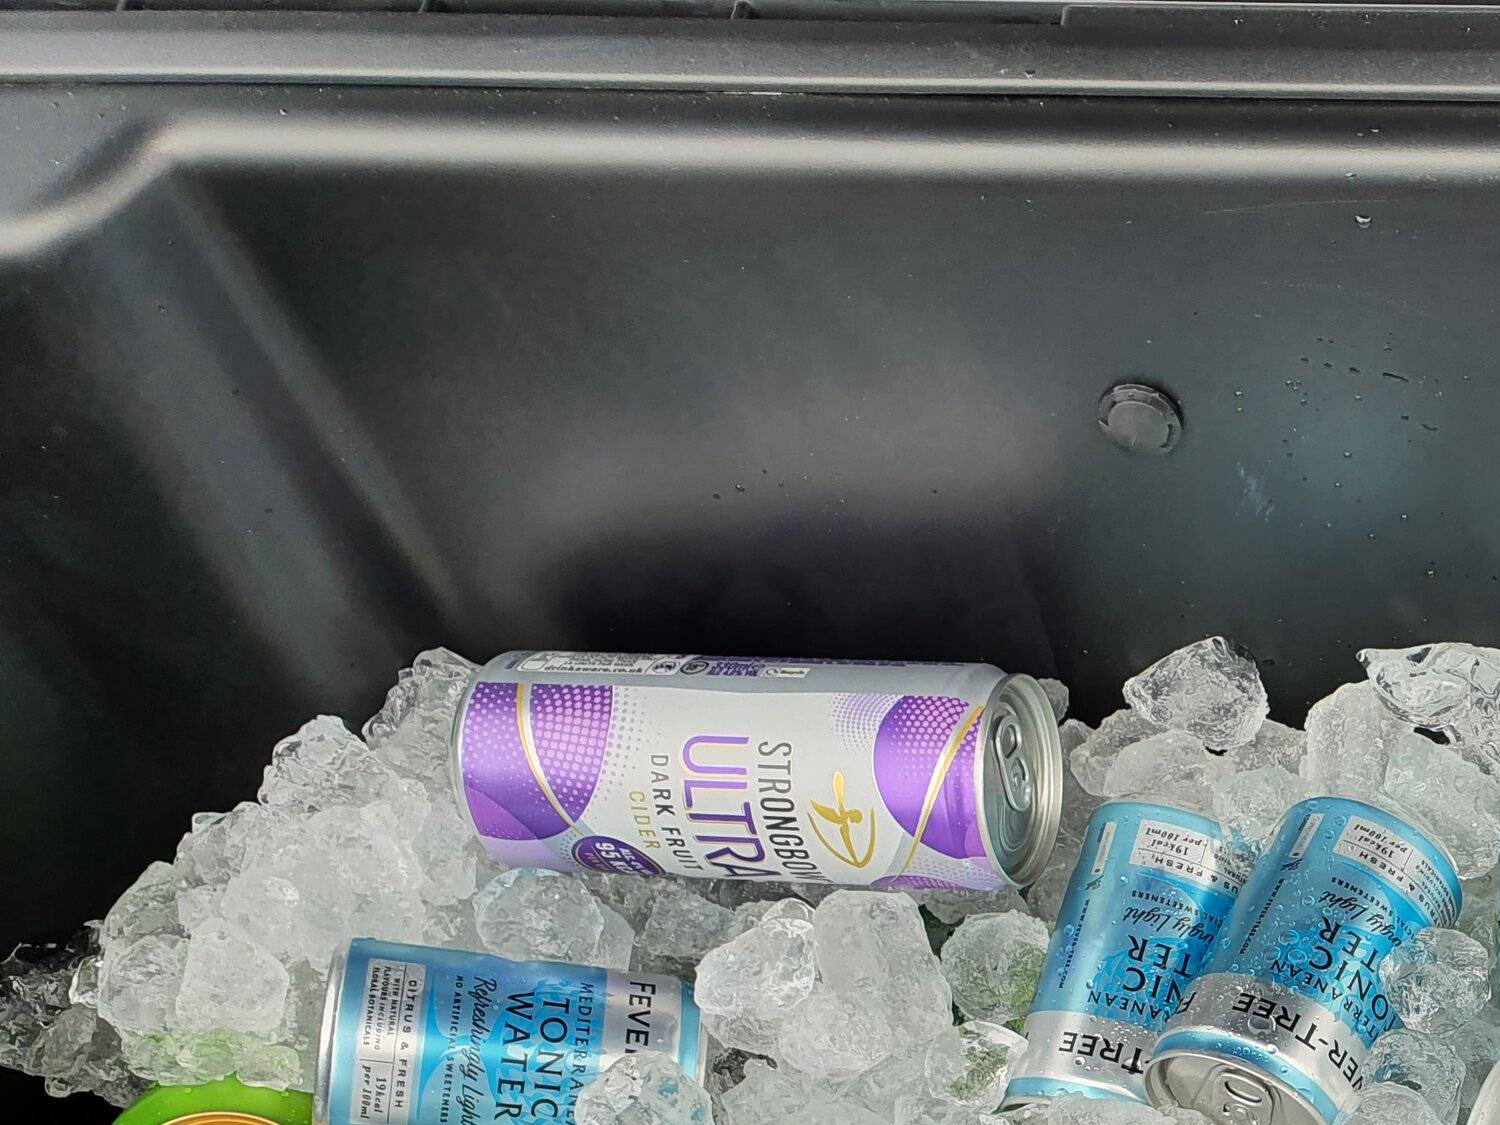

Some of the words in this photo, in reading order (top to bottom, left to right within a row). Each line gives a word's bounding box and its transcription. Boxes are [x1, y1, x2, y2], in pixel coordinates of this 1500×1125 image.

[545, 665, 642, 673] drinkaware.co.uk
[651, 755, 675, 815] DARK
[630, 791, 661, 849] CIDER
[683, 736, 781, 876] ULTRA
[662, 827, 703, 870] FRUIT
[1145, 827, 1179, 841] 100ml
[1150, 839, 1188, 856] 19kcal
[1183, 834, 1203, 846] per
[1354, 824, 1388, 842] 100ml
[1357, 836, 1394, 859] 19kcal
[1389, 841, 1408, 853] per
[1154, 856, 1204, 877] FRESH
[1358, 852, 1404, 882] FRESH
[1131, 890, 1199, 916] SWEETENERS
[1318, 891, 1368, 920] Light
[1331, 877, 1393, 917] SWEETENERS
[1122, 906, 1170, 932] Light
[455, 976, 464, 988] NO
[364, 994, 376, 1046] BOTANICALS
[386, 999, 397, 1035] NATURAL
[403, 980, 417, 1033] CITRUS
[448, 992, 462, 1051] ARTIFICIAL
[625, 981, 656, 1053] FEVE
[400, 1042, 409, 1051] &
[459, 977, 497, 1081] Refreshingly
[494, 992, 535, 1120] WATER
[530, 998, 570, 1118] TONIC
[361, 1065, 371, 1084] per
[394, 1059, 408, 1108] FRESH
[439, 1056, 455, 1123] SWEETENERS
[360, 1086, 371, 1120] 100ml
[374, 1076, 387, 1113] 19kcal
